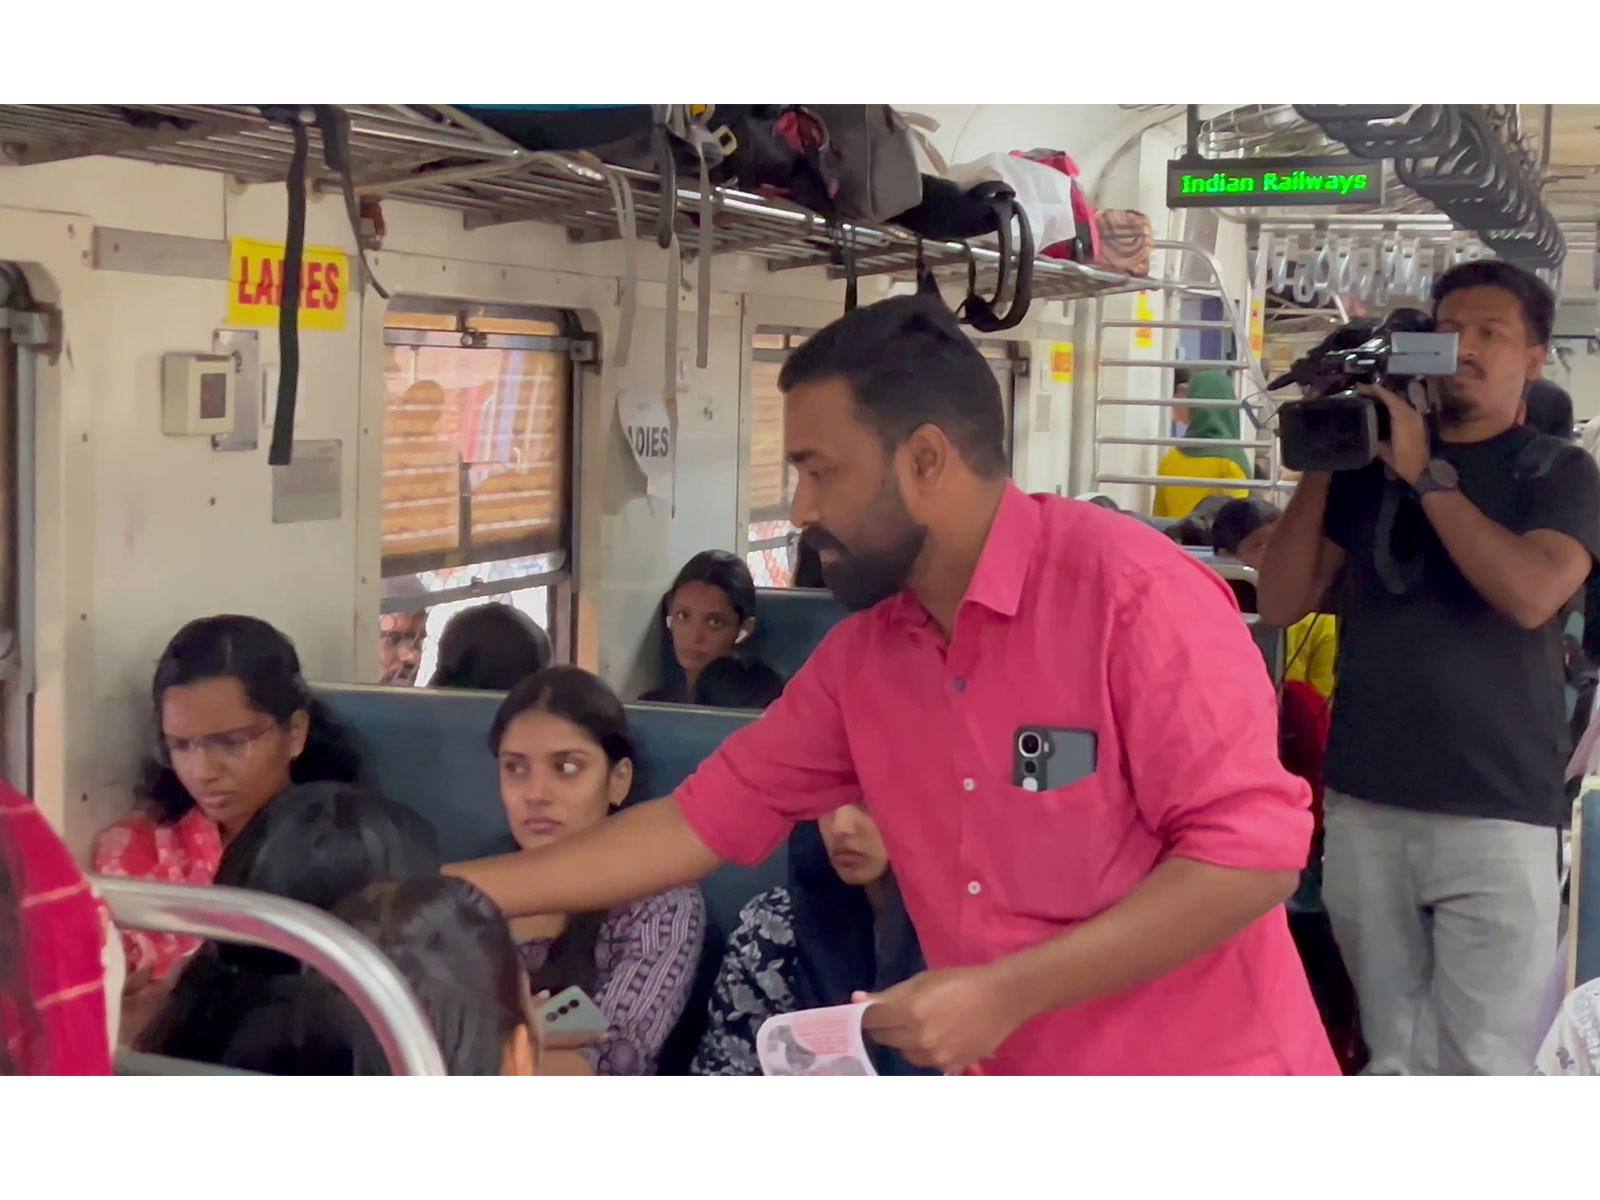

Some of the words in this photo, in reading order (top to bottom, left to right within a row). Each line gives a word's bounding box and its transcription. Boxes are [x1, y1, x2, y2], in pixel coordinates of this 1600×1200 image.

[1181, 173, 1255, 193] Indian
[1263, 171, 1367, 194] Railways
[238, 256, 340, 310] LAES
